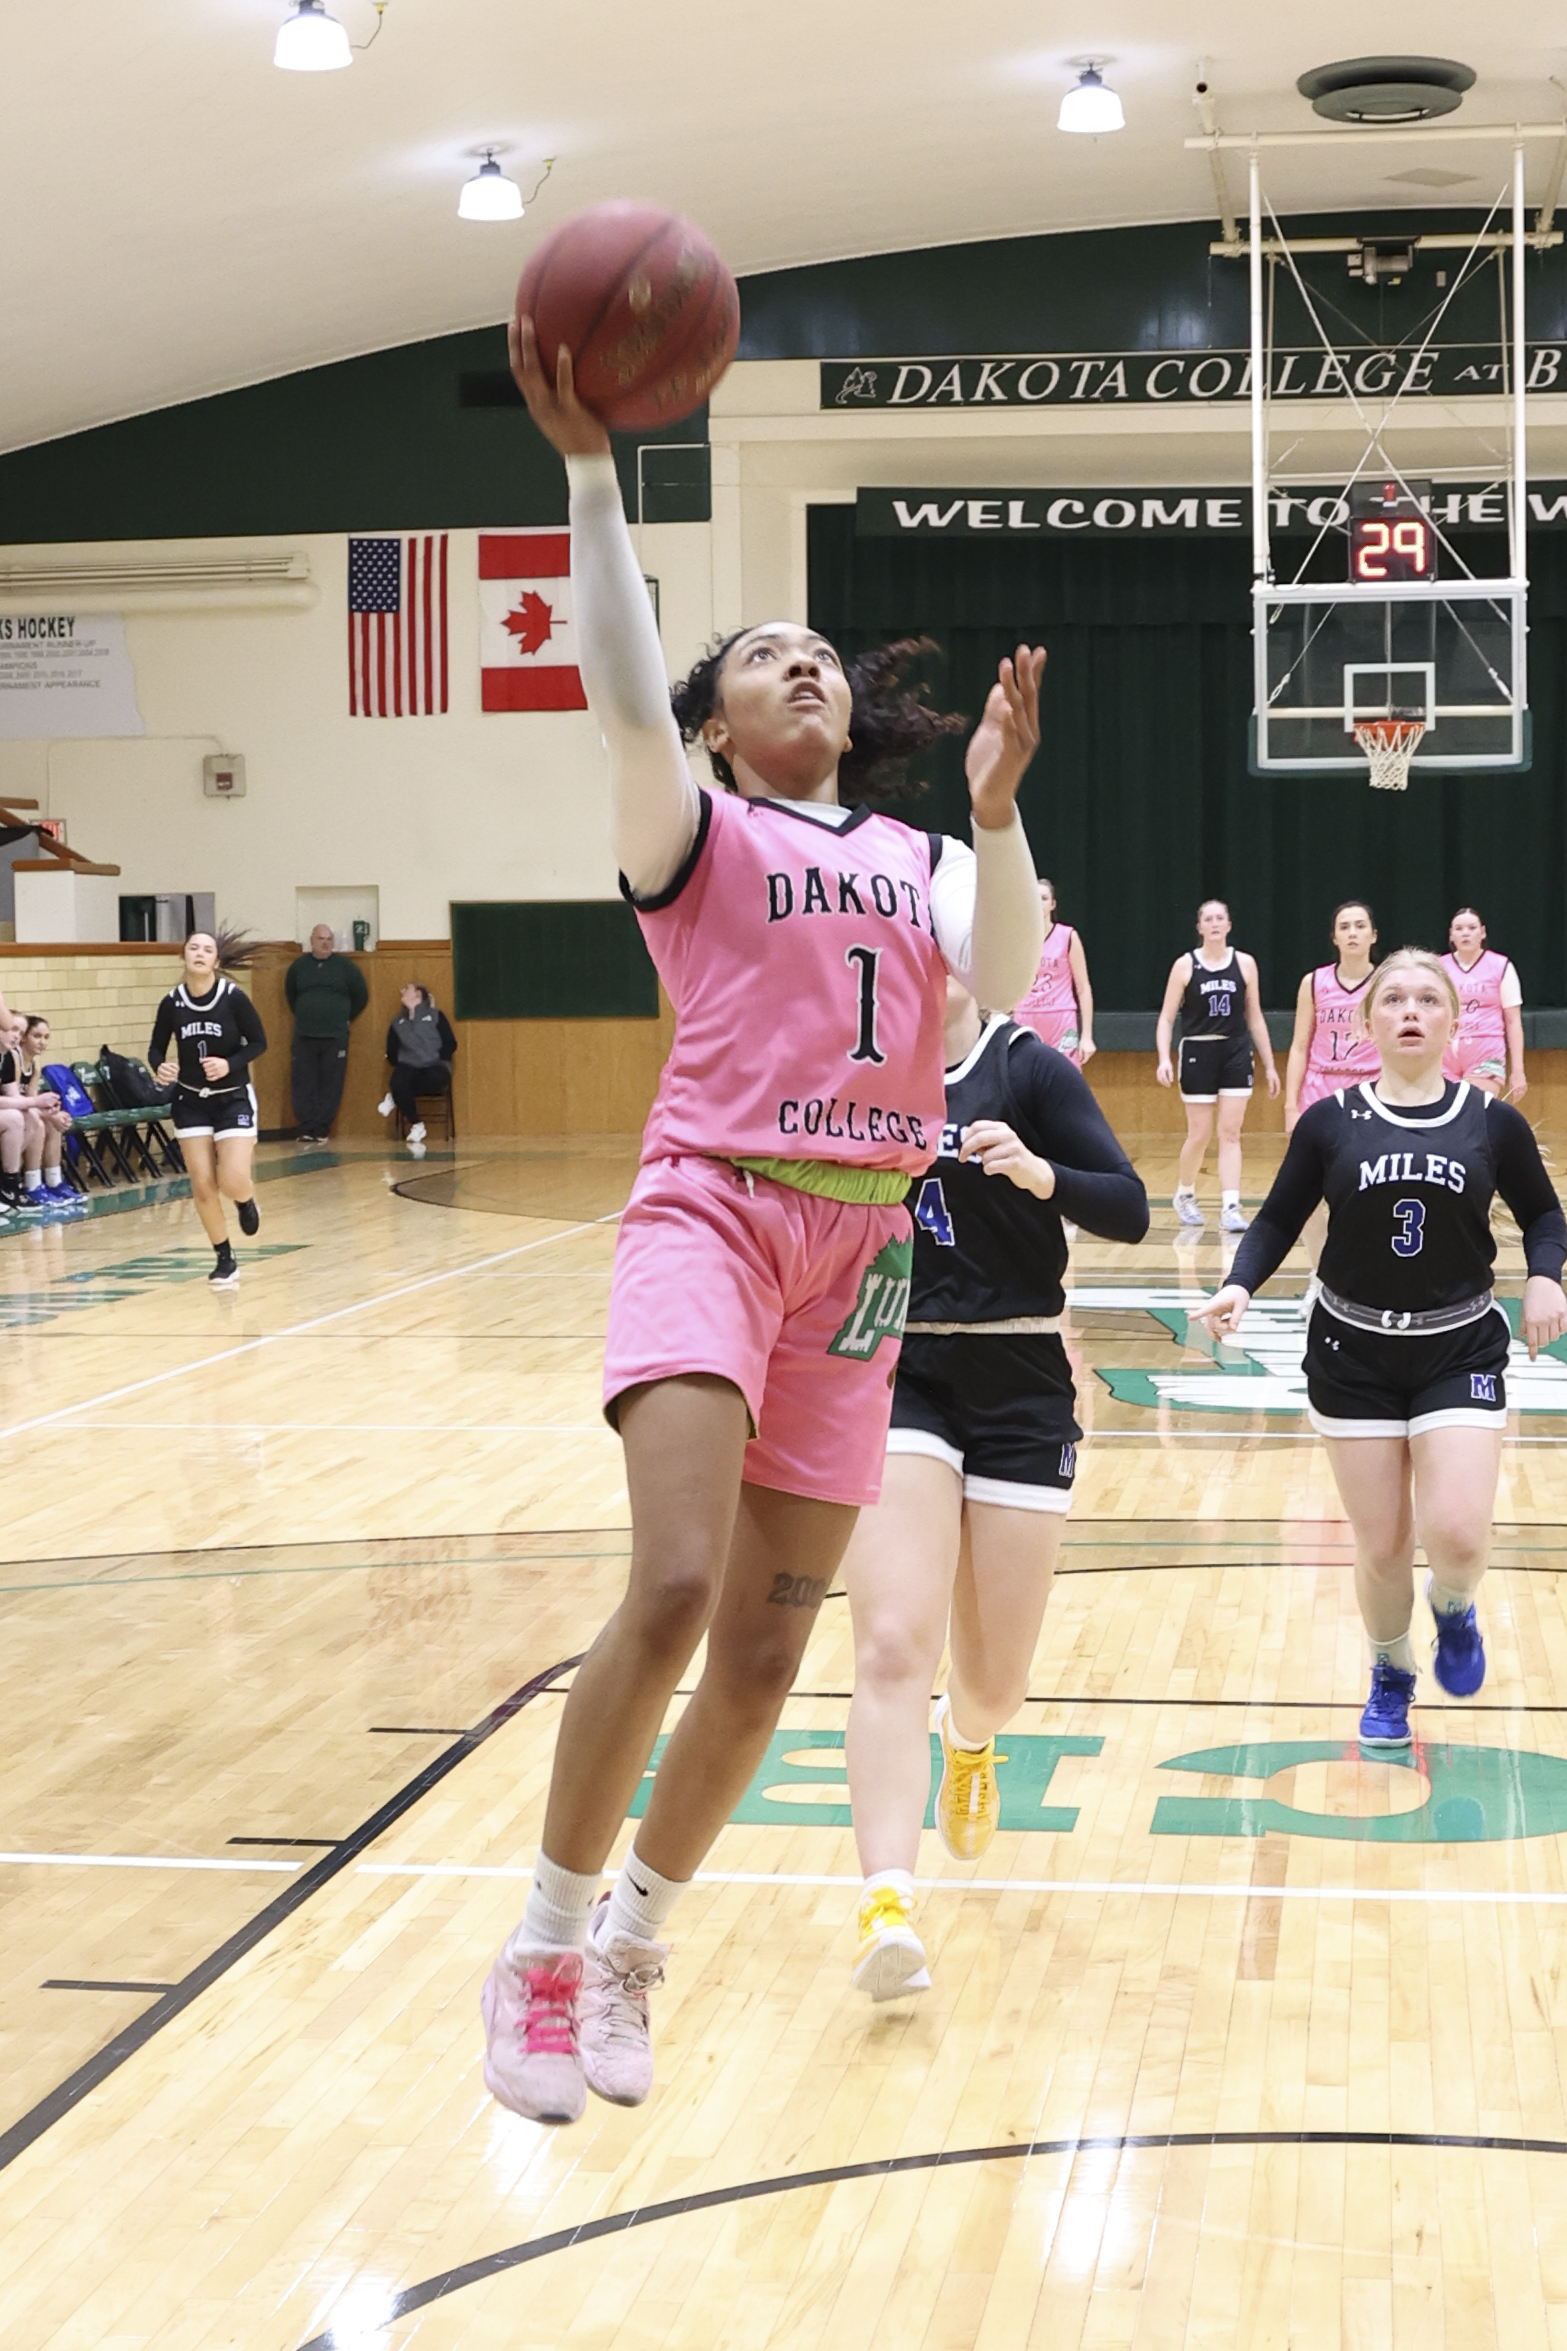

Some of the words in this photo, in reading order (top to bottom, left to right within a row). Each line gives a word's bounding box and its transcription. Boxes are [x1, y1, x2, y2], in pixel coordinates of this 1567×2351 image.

[886, 359, 1129, 405] DAKOTA
[1144, 350, 1441, 399] COLLEGE
[1453, 363, 1508, 383] AT
[1525, 348, 1567, 389] B
[892, 498, 1243, 529] WELCOME
[1265, 496, 1350, 527] TO
[1357, 520, 1427, 578] 29
[18, 615, 75, 639] HOCKEY
[766, 866, 921, 928] DAKOT
[846, 943, 887, 1067] 1
[1200, 979, 1237, 995] MILES
[1208, 994, 1231, 1017] 14
[181, 1021, 223, 1040] MILES
[197, 1040, 208, 1058] 1
[778, 1098, 928, 1151] COLLEGE
[1358, 1152, 1466, 1194] MILES
[914, 1177, 956, 1246] 4
[1391, 1198, 1426, 1257] 3
[1470, 1373, 1497, 1402] M
